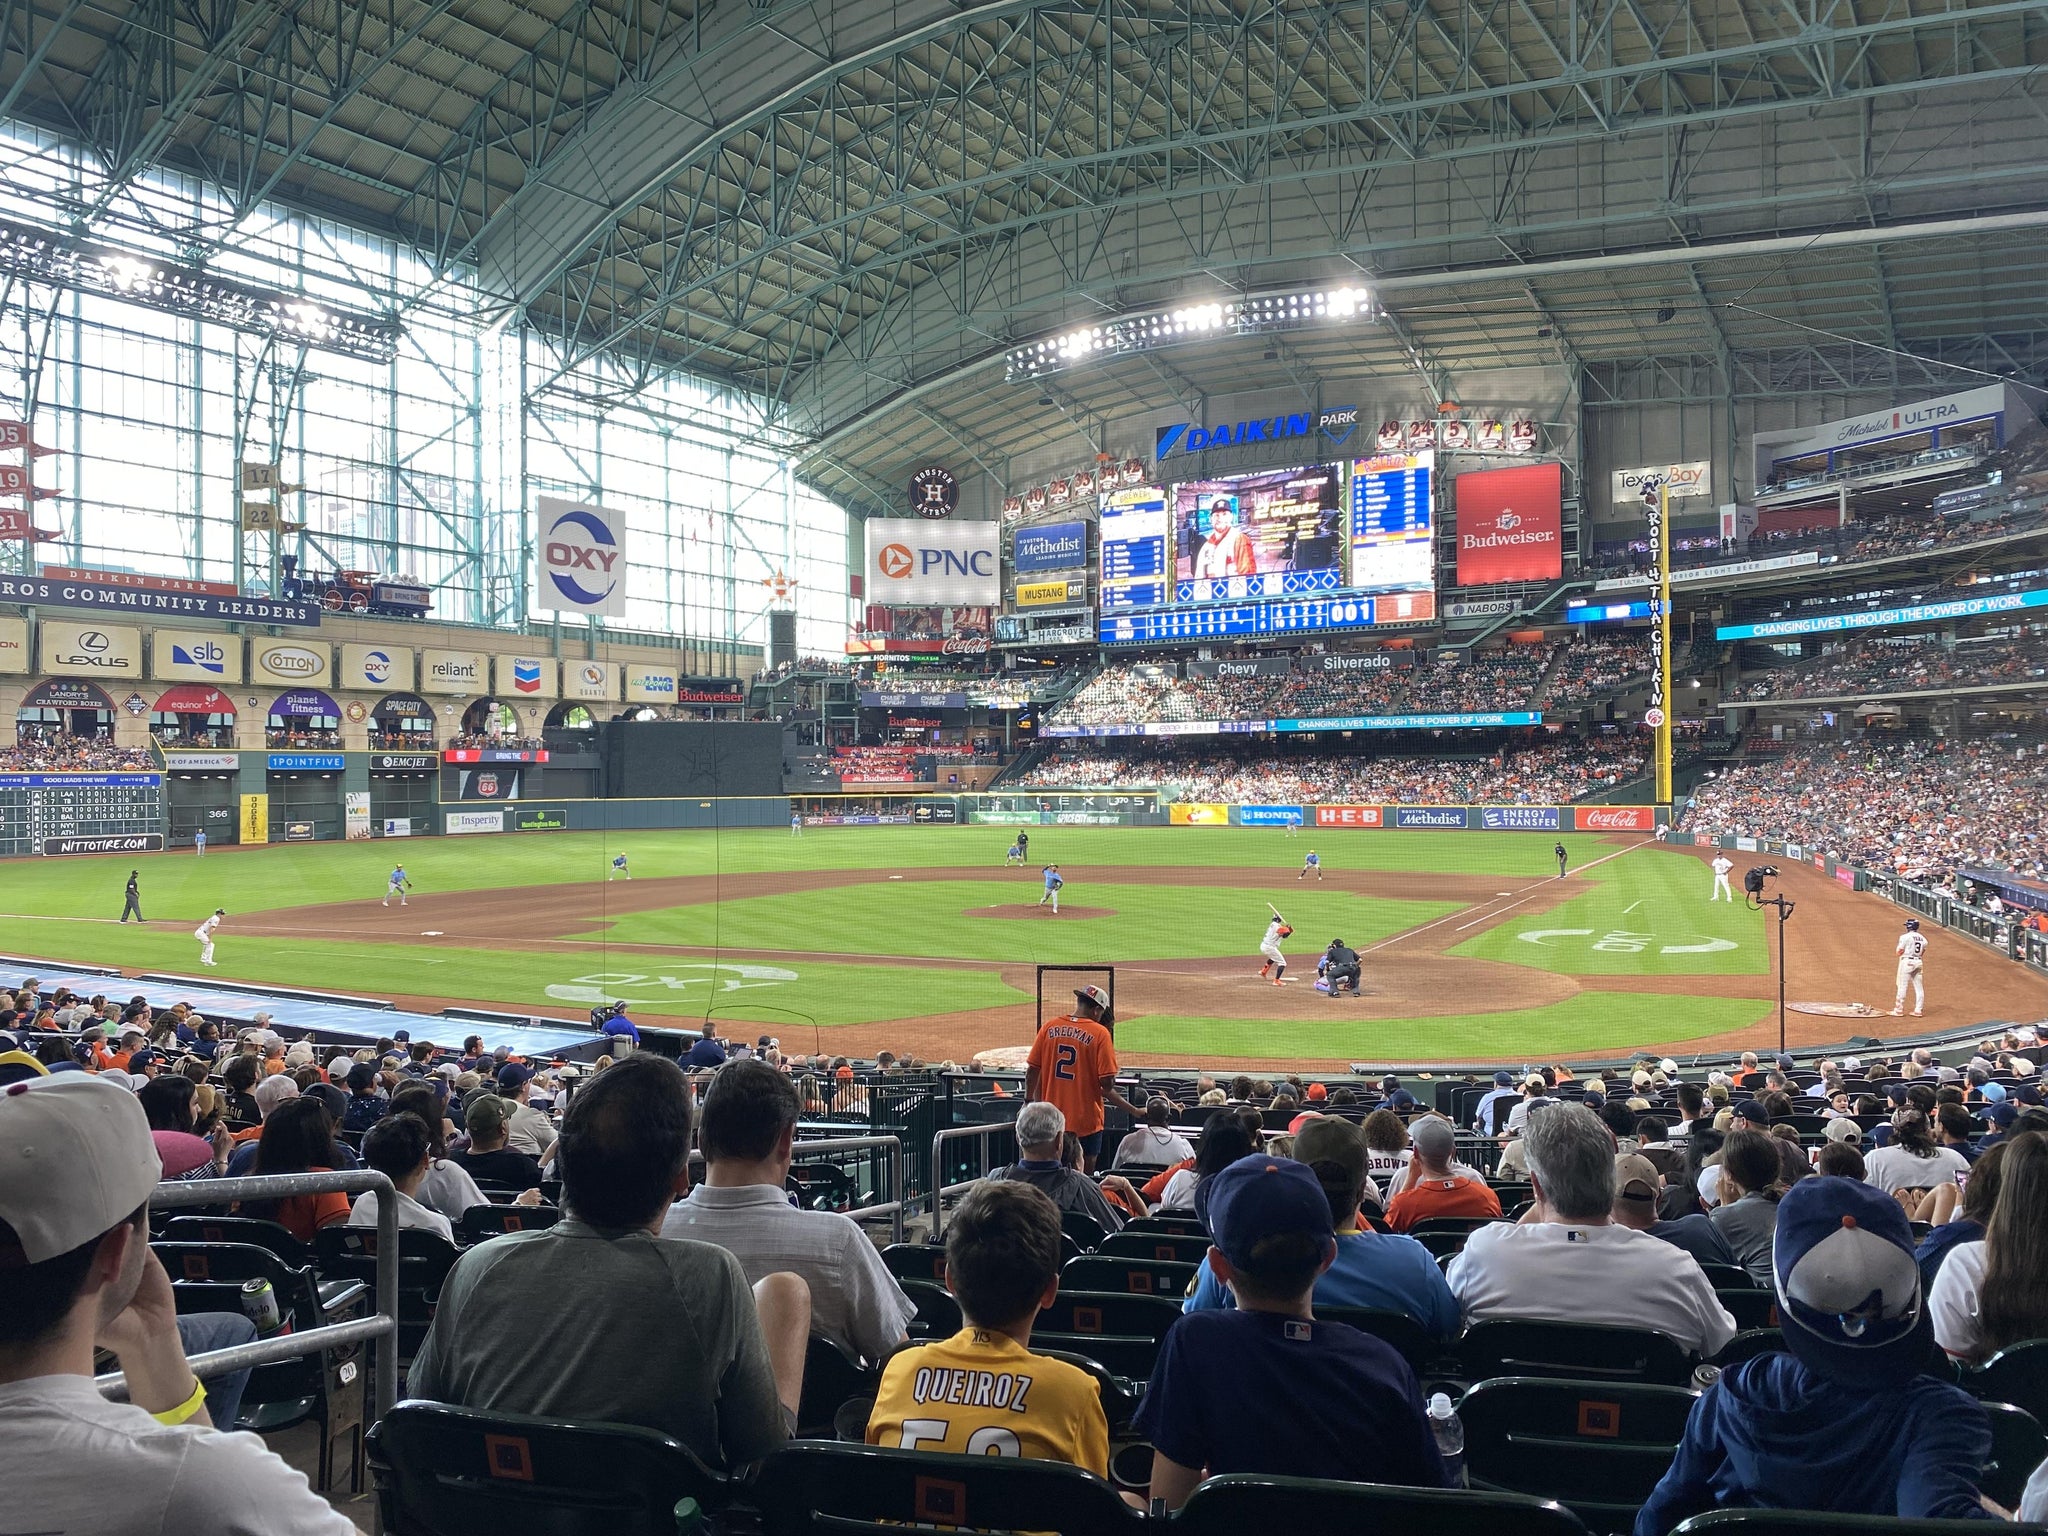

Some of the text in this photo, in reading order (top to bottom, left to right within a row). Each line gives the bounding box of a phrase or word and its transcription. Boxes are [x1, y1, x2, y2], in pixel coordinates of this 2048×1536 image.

[1378, 420, 1400, 437] 49
[1409, 420, 1433, 437] 24
[1449, 420, 1460, 437] 5
[1482, 420, 1494, 437] 7
[1512, 420, 1534, 437] 13
[1837, 403, 1959, 441] Michelob ULTRA
[1186, 410, 1358, 452] DAIKIN PARK
[1363, 456, 1408, 472] ASTROS
[252, 469, 270, 483] 17
[914, 469, 953, 484] HOUSTON
[1670, 467, 1703, 483] Bay
[925, 484, 943, 502] H
[1050, 480, 1066, 494] 25
[1120, 490, 1152, 503] BREWERS
[251, 510, 270, 524] 22
[916, 503, 951, 516] ASTROS
[1020, 537, 1080, 556] Methodist
[546, 542, 618, 572] OXY
[918, 549, 993, 577] PNC
[69, 570, 209, 592] DAIKIN PARK
[1025, 585, 1083, 600] MUSTANG CAT
[63, 587, 208, 612] COMMUNITY
[218, 601, 307, 620] LEADERS
[1360, 602, 1370, 620] 1
[1467, 602, 1512, 614] NABORS
[1648, 512, 1663, 706] ROOT 4 THA CHIKIN
[1753, 620, 1810, 637] CHANGING
[1811, 617, 1842, 631] LIVES
[1844, 611, 1900, 628] THROUGH
[1901, 607, 1923, 621] THE
[1924, 602, 1966, 619] POWER
[1968, 599, 1985, 612] OF
[193, 642, 224, 660] slb
[941, 636, 991, 655] Coca-Cola
[55, 654, 129, 668] LEXUS
[268, 653, 315, 672] COTTON
[514, 658, 540, 666] Chevron
[873, 654, 911, 662] HORNITOS
[1323, 655, 1390, 669] Silverado
[433, 662, 475, 677] reliant
[1218, 663, 1258, 676] Chevy
[630, 679, 668, 687] FREEPORT
[645, 675, 674, 692] LNG
[287, 694, 318, 705] planet
[679, 690, 744, 702] Budweiser
[171, 701, 203, 709] equinor
[291, 703, 324, 713] fitness
[385, 700, 422, 712] SPACE CITY
[888, 716, 942, 727] Budweiser
[1297, 719, 1340, 729] CHANGING
[1341, 719, 1364, 727] LIVES
[1427, 717, 1460, 725] POWER
[272, 757, 340, 767] 1POINTFIVE
[392, 756, 428, 767] EMCJET
[863, 774, 905, 782] Budweiser
[482, 783, 494, 791] 66
[208, 810, 228, 818] 366
[348, 807, 368, 815] WM
[1253, 811, 1301, 819] HONDA
[1401, 811, 1461, 826] Methodist
[1503, 809, 1546, 818] ENERGY
[1587, 809, 1640, 828] Coca-Cola
[461, 815, 500, 826] Insperity
[1504, 818, 1557, 827] TRANSFER
[61, 838, 148, 853] NITTOTIRE.COM
[1914, 942, 1922, 954] 3
[1048, 1025, 1094, 1046] BREGMAN
[1055, 1044, 1077, 1081] 2
[226, 1105, 243, 1119] GGIO
[341, 1364, 356, 1381] 20
[913, 1366, 1033, 1414] QUEIROZ
